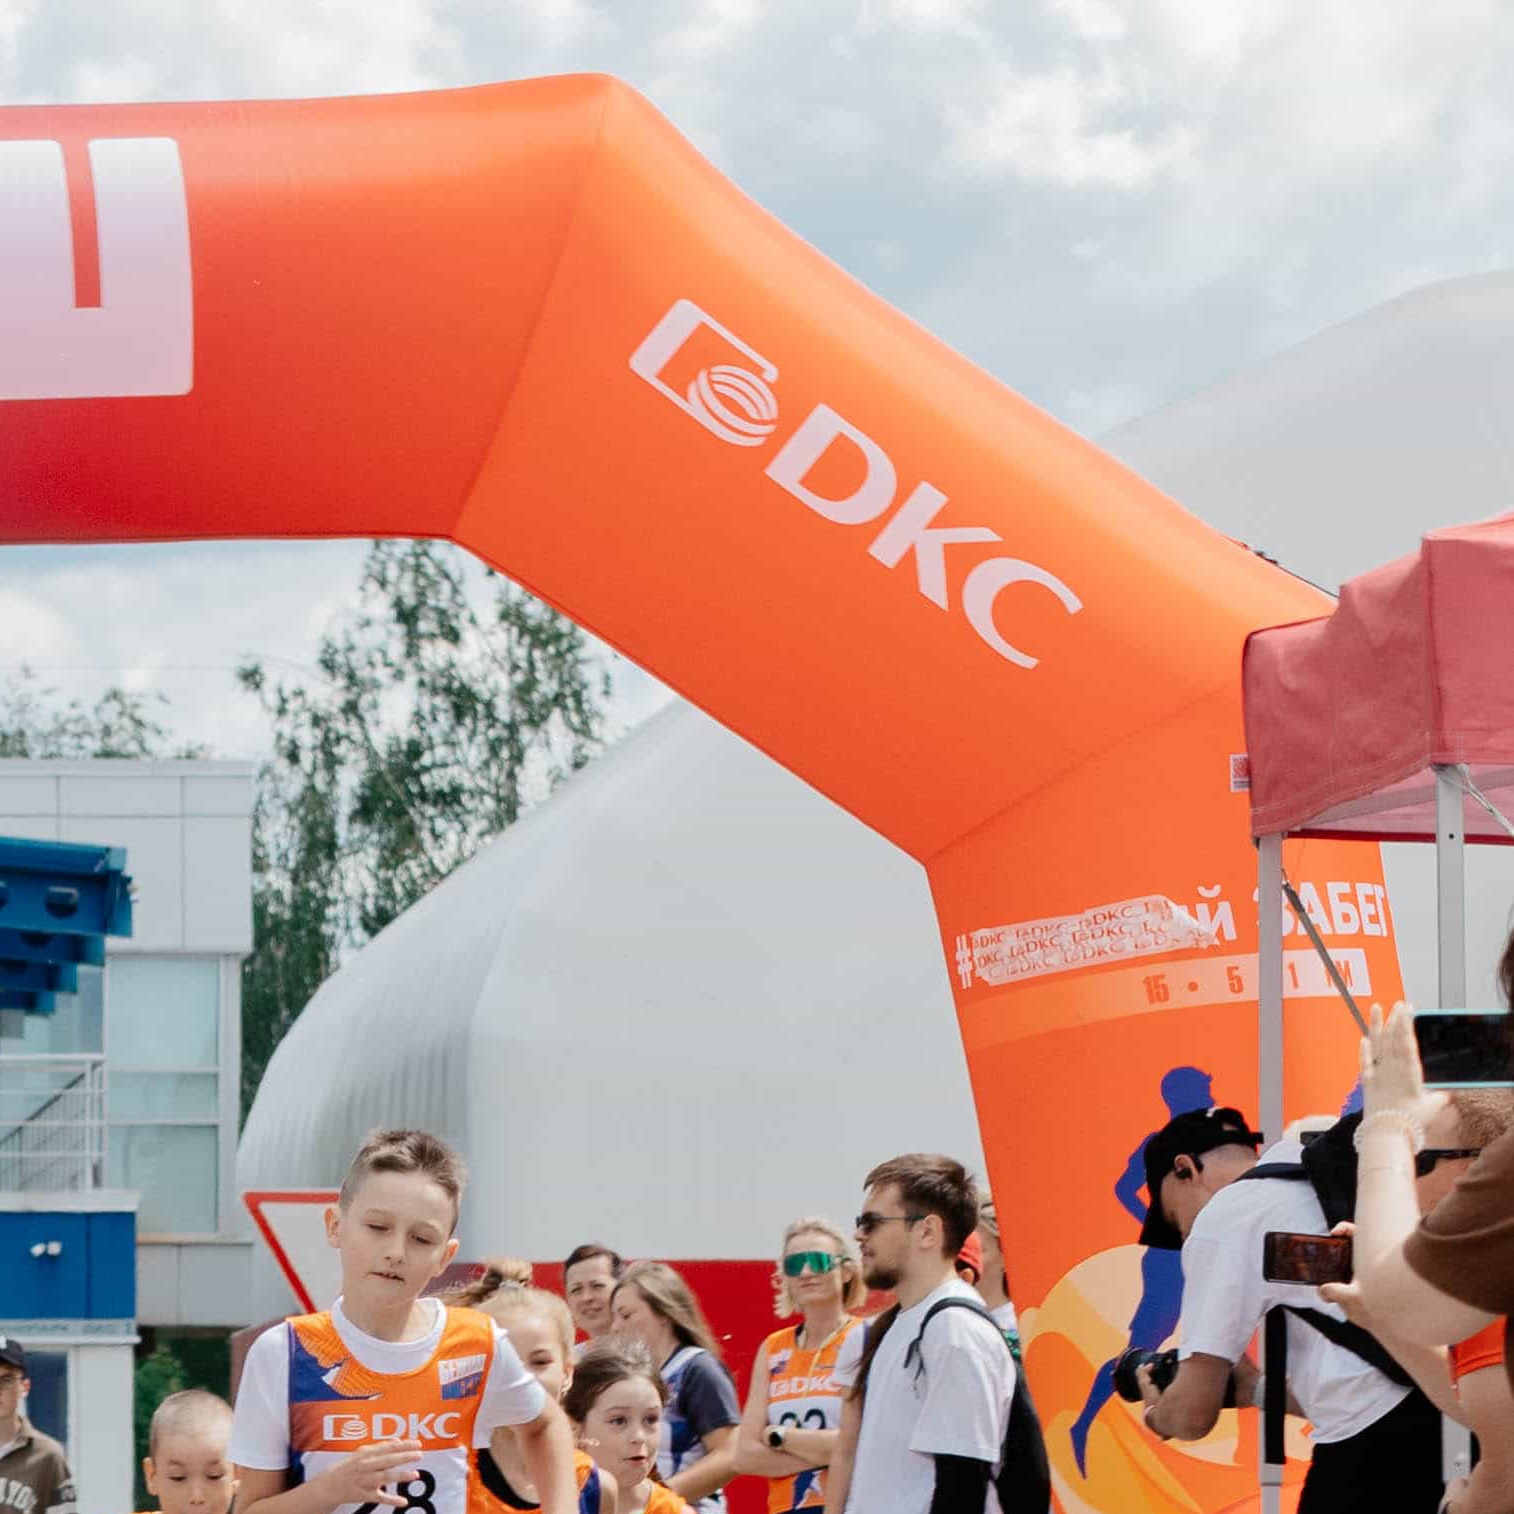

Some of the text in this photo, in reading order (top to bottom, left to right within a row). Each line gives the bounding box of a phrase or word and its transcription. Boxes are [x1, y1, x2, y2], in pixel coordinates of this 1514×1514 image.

[764, 402, 1084, 670] DKC
[1142, 973, 1171, 1004] 15
[1226, 965, 1244, 994] 5
[1287, 961, 1299, 989] 1
[371, 1411, 462, 1441] DKC
